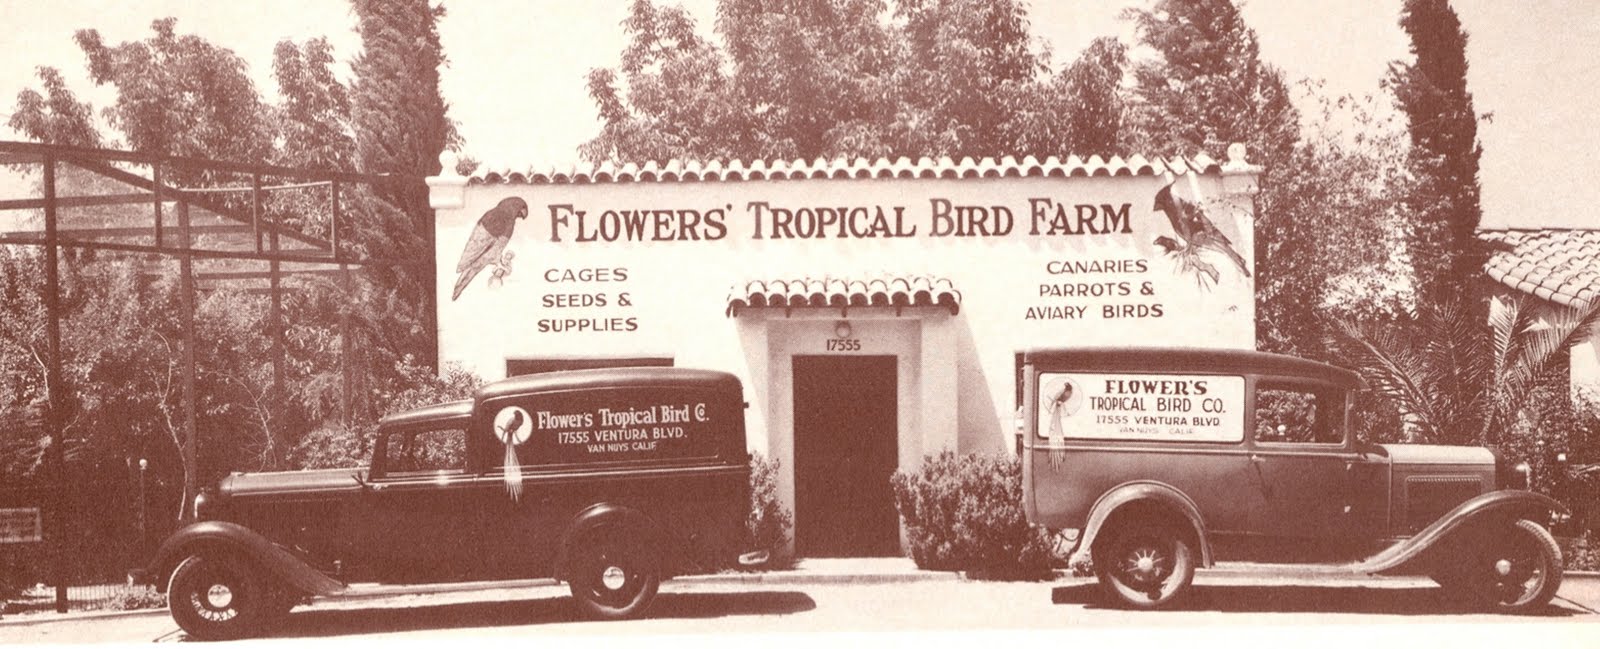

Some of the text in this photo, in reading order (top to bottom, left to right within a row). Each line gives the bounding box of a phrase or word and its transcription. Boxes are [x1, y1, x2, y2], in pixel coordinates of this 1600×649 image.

[548, 198, 1133, 242] FLOWERS' TROPICAL BIRD FARM
[543, 267, 628, 282] CAGES
[1046, 259, 1149, 275] CANARIES
[1039, 281, 1155, 297] PARROTS &
[541, 292, 633, 309] SEEDS &
[1024, 303, 1164, 320] AVIARY BIRDS
[537, 317, 639, 333] SUPPLIES
[825, 338, 862, 351] 17555
[1105, 380, 1208, 395] FLOWER'S
[1089, 396, 1226, 413] TROPICAL BIRD CO.
[537, 411, 593, 430] Flower's
[598, 406, 657, 430] Tropical
[660, 404, 690, 424] Bird
[1096, 415, 1129, 425] 17555
[1134, 416, 1188, 426] VENTURA
[558, 426, 688, 444] 17555 VENTURA BLVD.
[587, 444, 605, 453] VAN
[607, 442, 629, 452] NUYS
